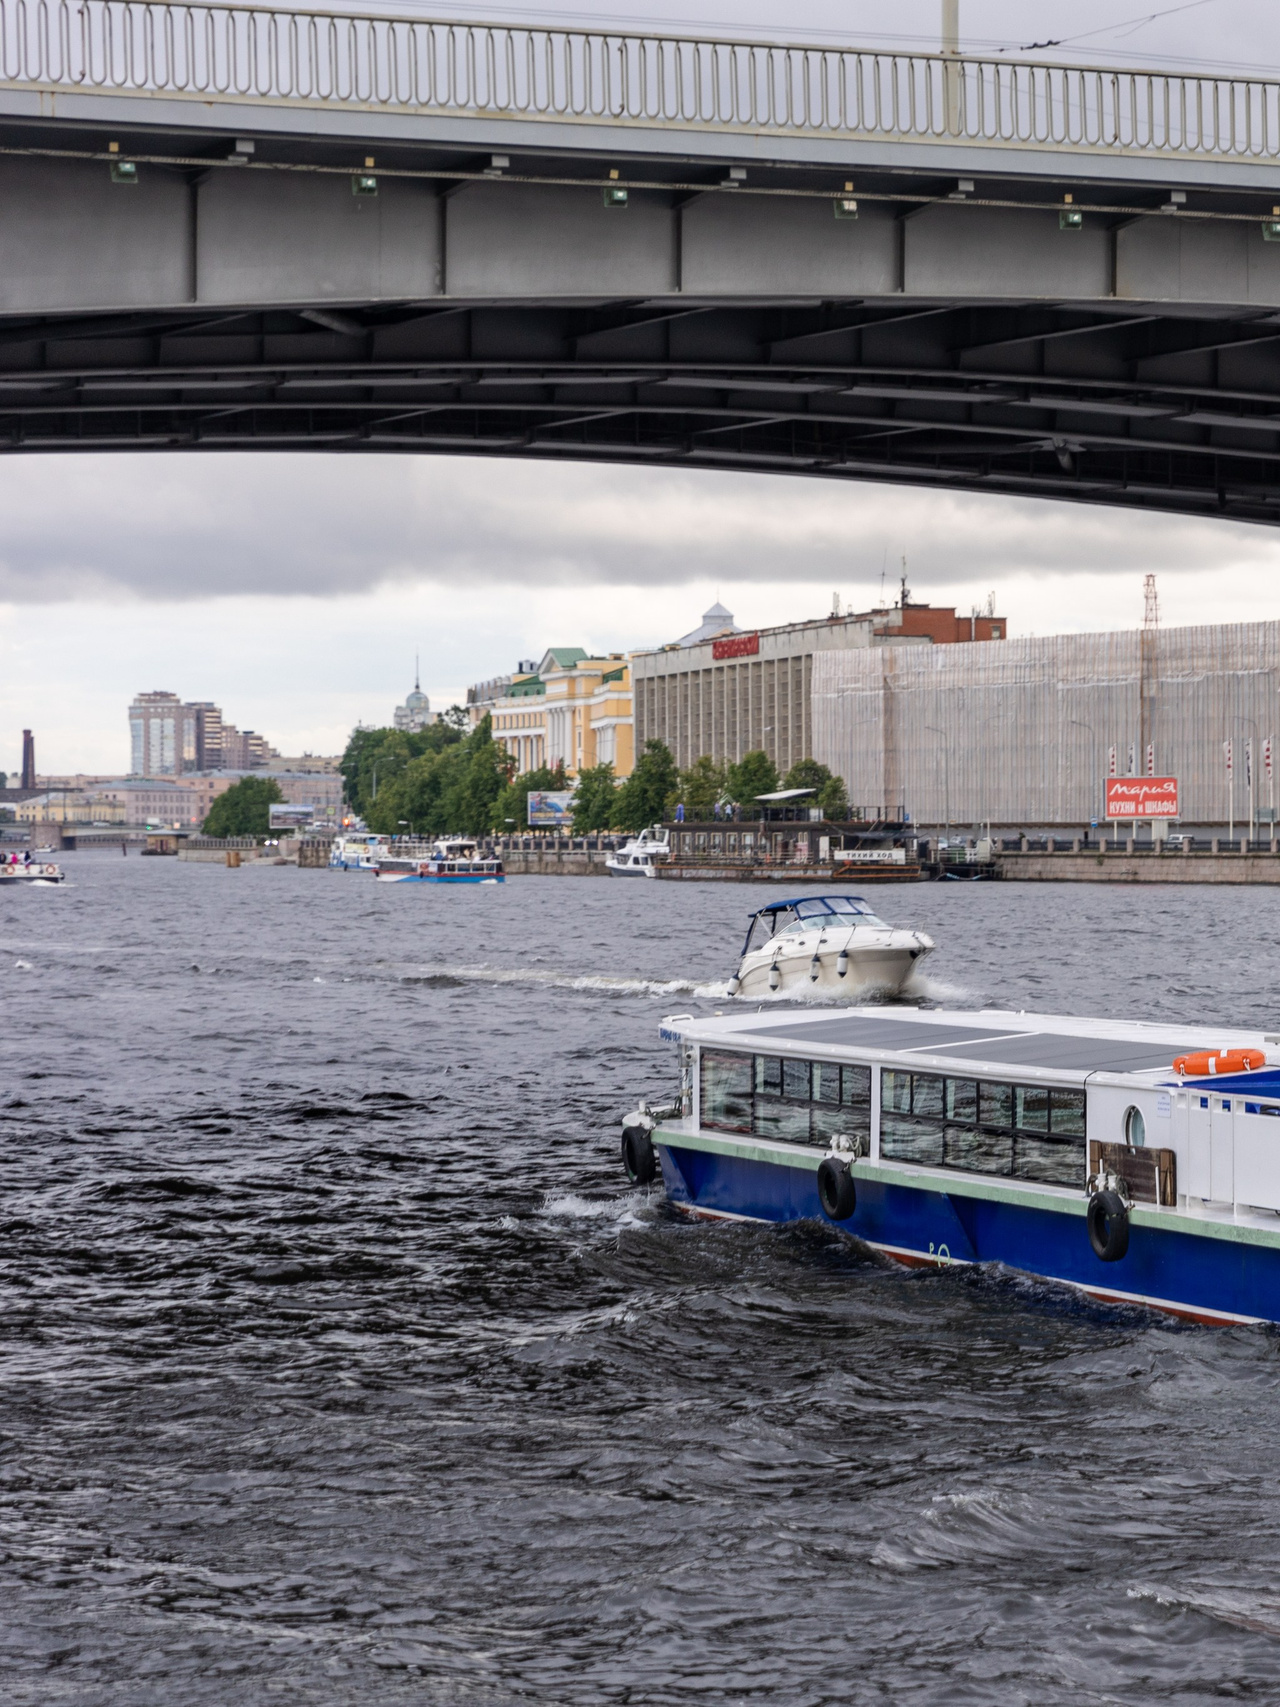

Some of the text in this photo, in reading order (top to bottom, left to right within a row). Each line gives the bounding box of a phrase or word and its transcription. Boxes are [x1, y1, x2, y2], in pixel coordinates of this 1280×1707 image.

[1109, 801, 1136, 814] КУХНИ
[1145, 800, 1177, 814] ШКАФЫ
[846, 851, 874, 859] ТИХИЙ
